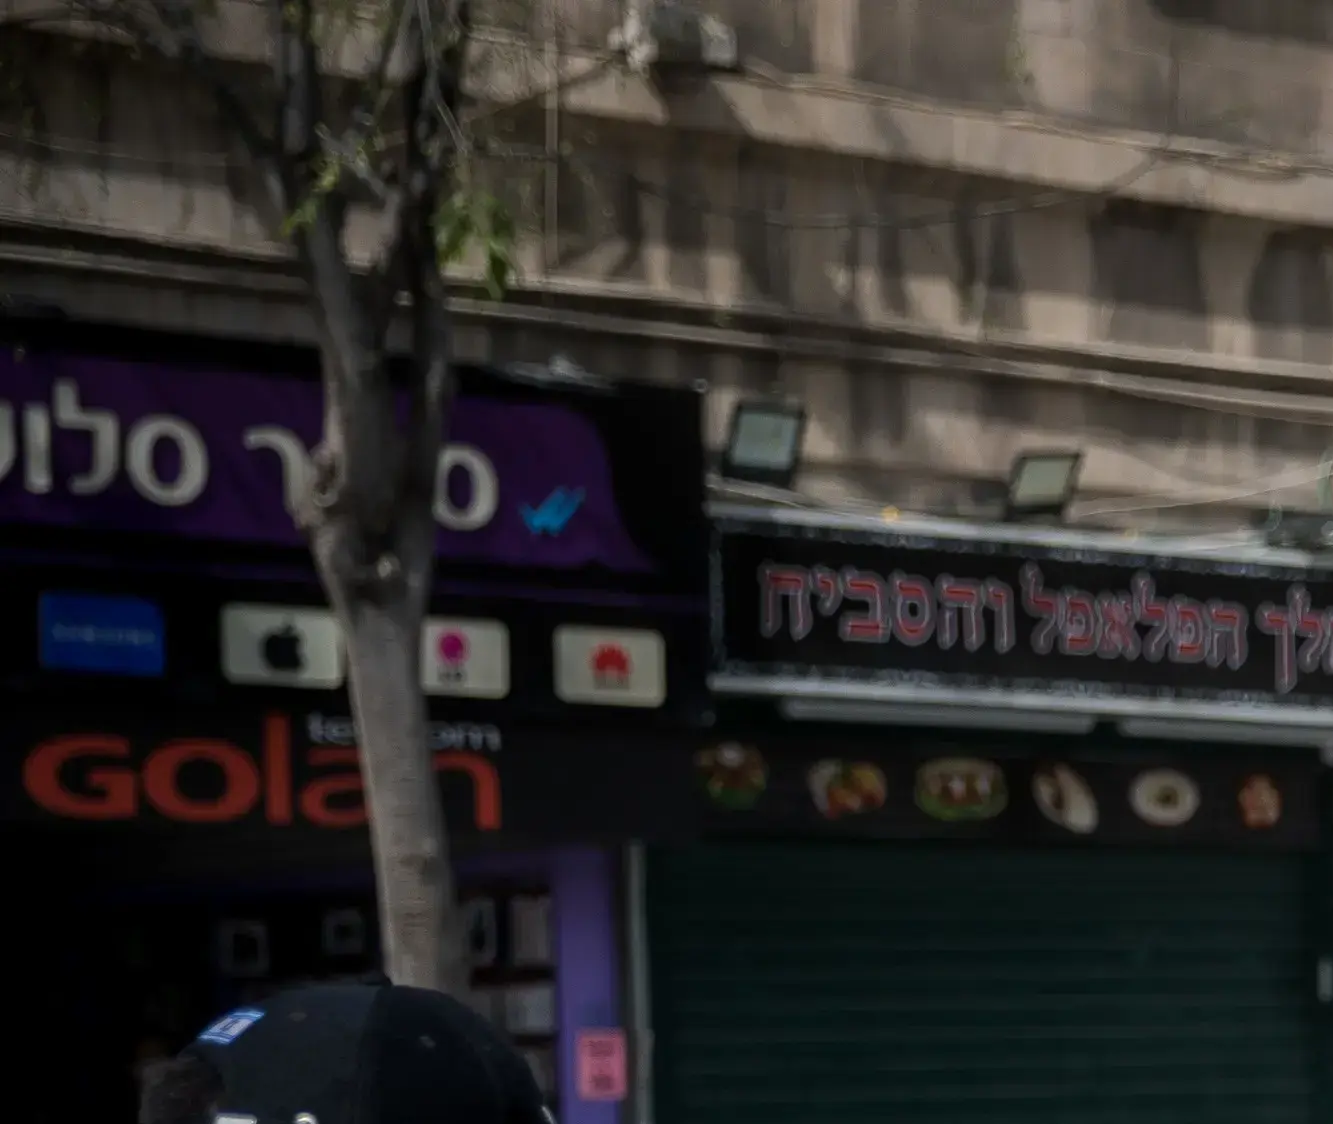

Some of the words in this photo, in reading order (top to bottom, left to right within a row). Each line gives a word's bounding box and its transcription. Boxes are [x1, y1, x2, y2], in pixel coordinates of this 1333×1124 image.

[0, 377, 210, 506] סלו
[757, 558, 1016, 655] והסביח
[1019, 560, 1249, 671] הפלאפל
